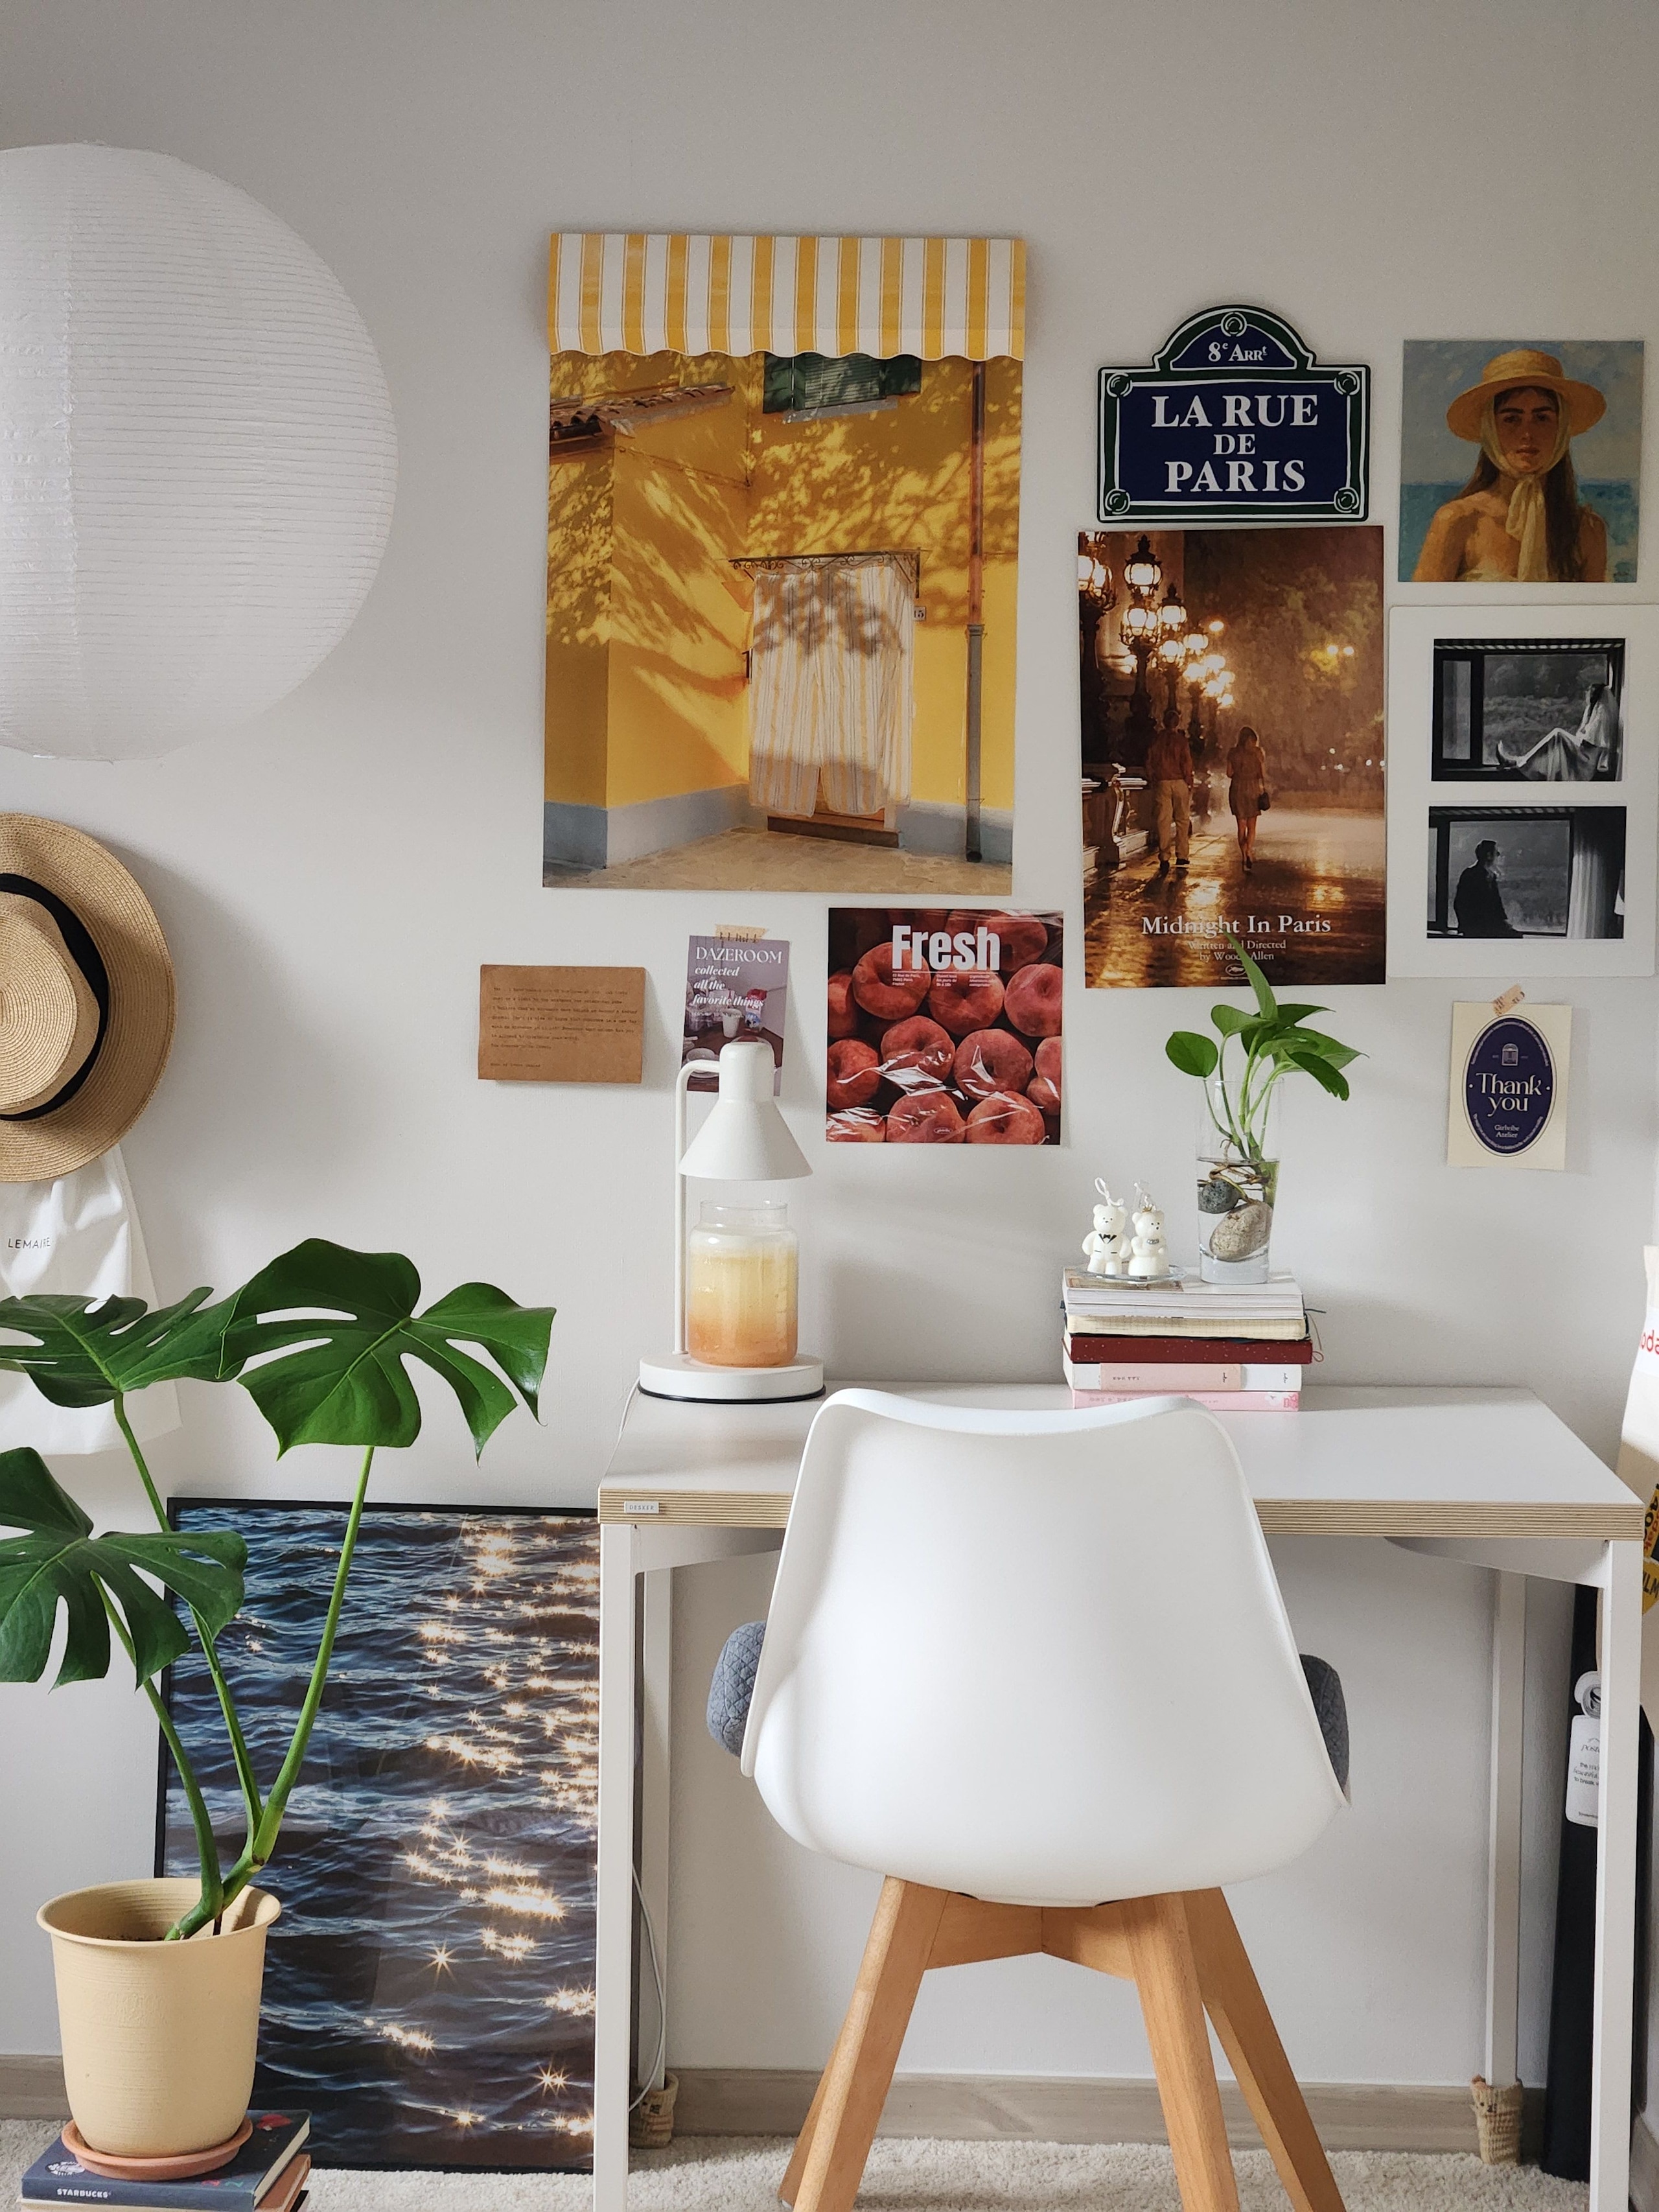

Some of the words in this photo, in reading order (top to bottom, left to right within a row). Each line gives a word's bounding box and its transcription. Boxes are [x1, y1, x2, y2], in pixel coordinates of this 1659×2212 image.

[1151, 395, 1212, 428] LA
[1222, 394, 1318, 427] RUE
[1213, 434, 1257, 455] DE
[1164, 460, 1306, 493] PARIS
[1141, 914, 1240, 939] Midnight
[1247, 916, 1270, 933] In
[1278, 914, 1332, 933] Paris
[892, 925, 1001, 971] Fresh
[1188, 940, 1225, 950] Written
[1247, 940, 1286, 949] Directed
[696, 947, 782, 964] DAZEROOM
[1200, 953, 1211, 963] by
[1251, 951, 1275, 960] Allen
[695, 965, 740, 977] collected
[693, 979, 708, 990] all
[708, 980, 726, 990] the
[693, 994, 732, 1005] favorite
[733, 996, 764, 1009] things
[1476, 1073, 1542, 1096] Thank
[1487, 1097, 1528, 1117] you
[8, 1237, 51, 1249] LEMAIRE
[57, 2188, 109, 2198] STARBUCKS
